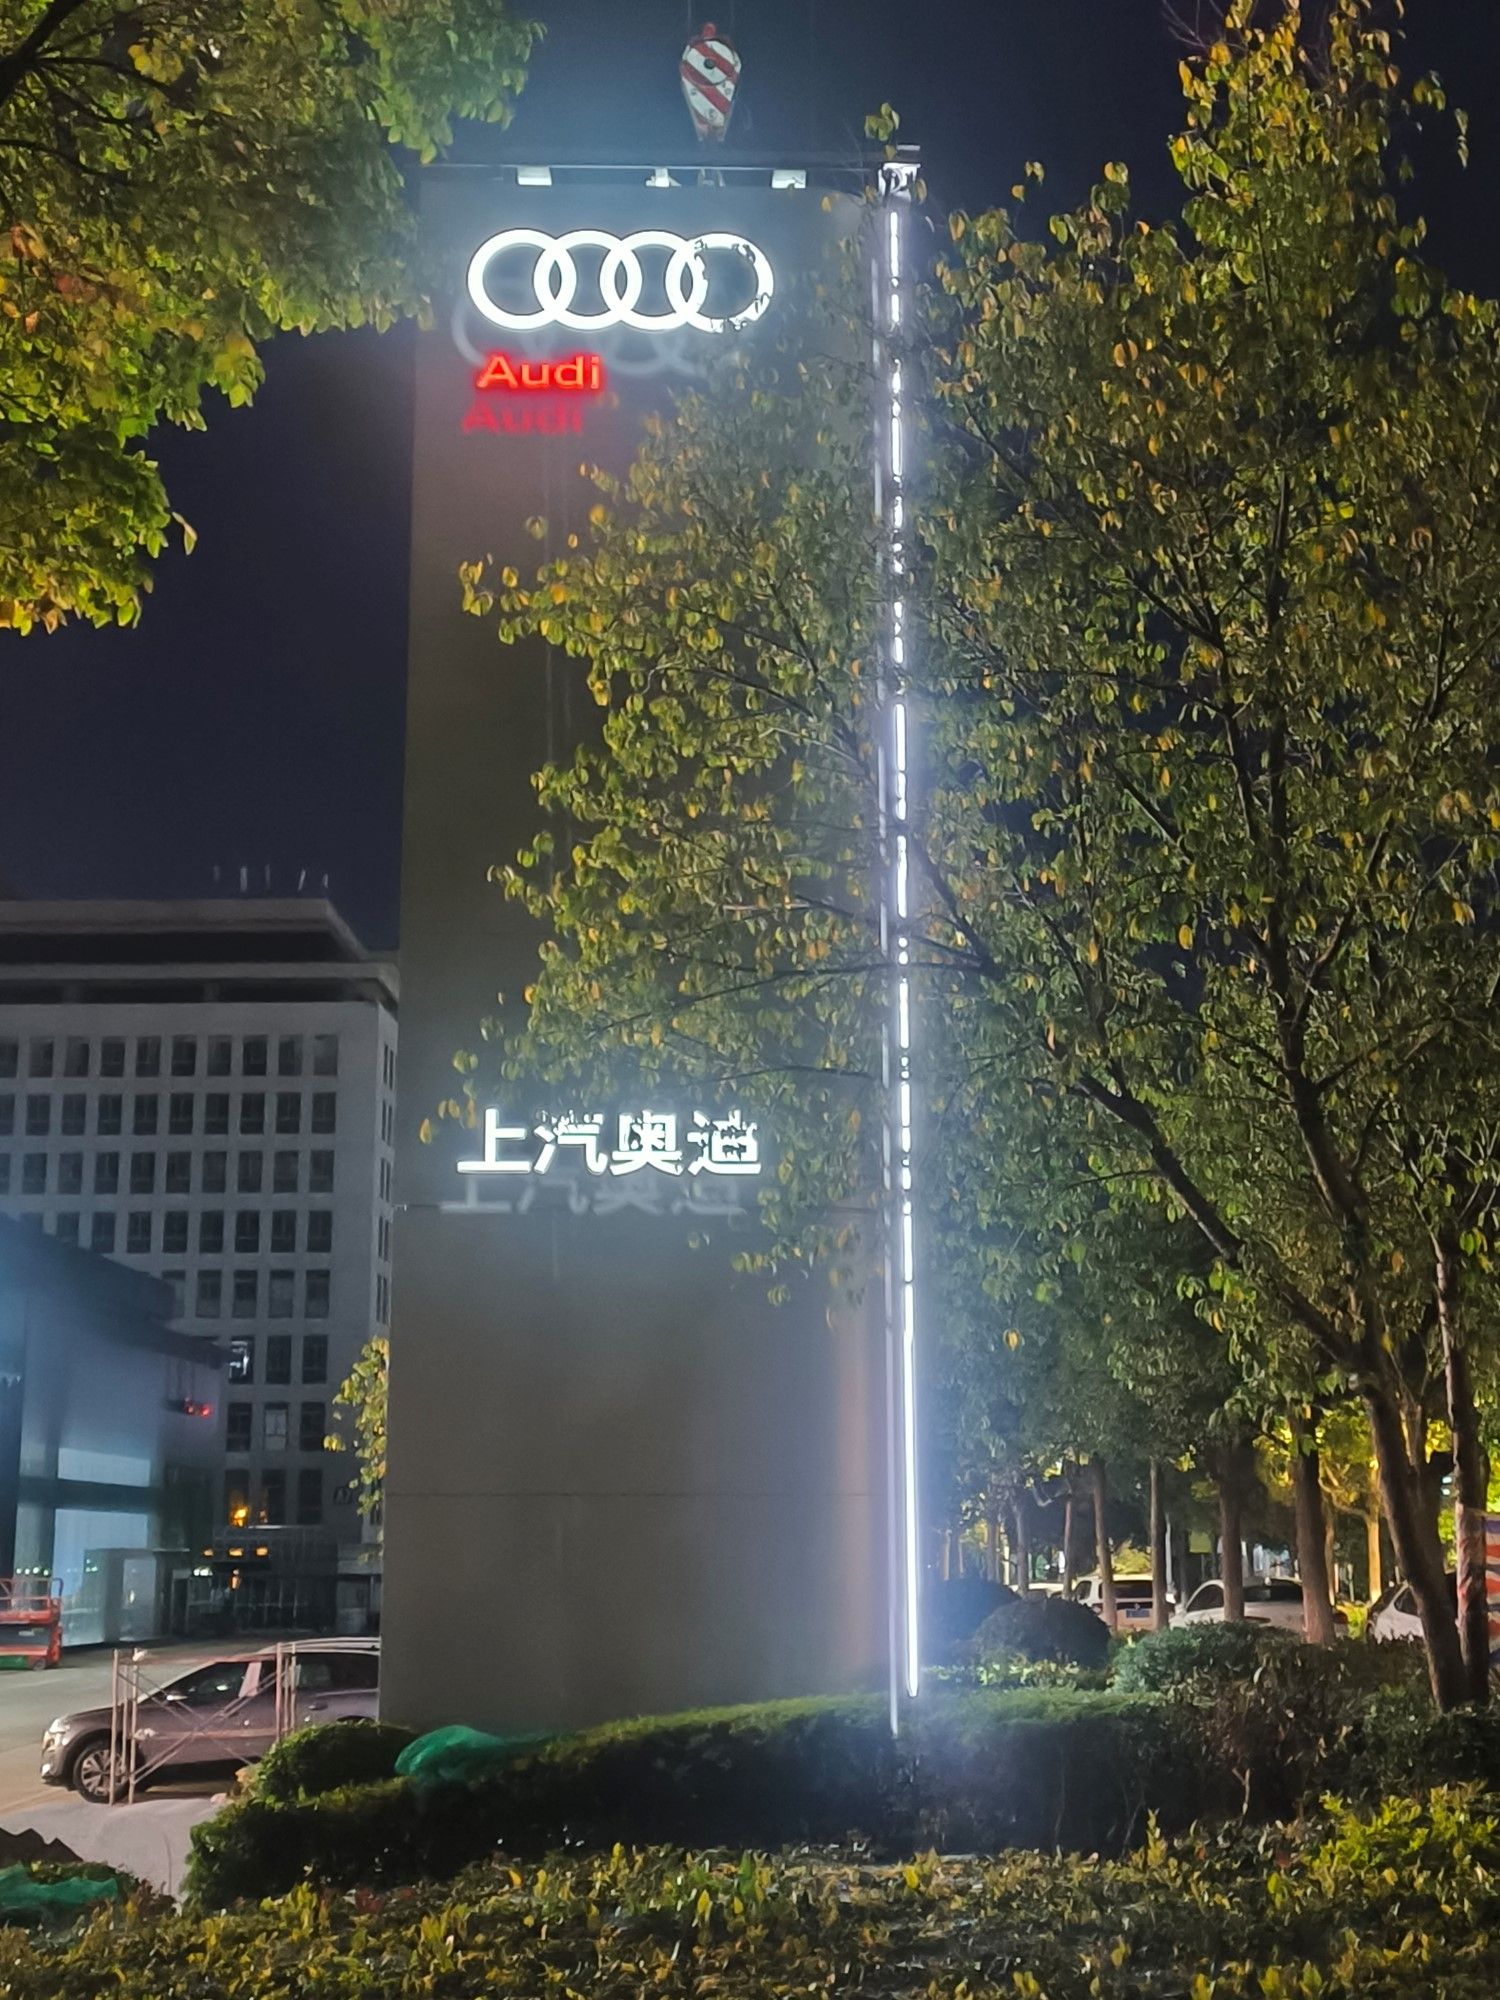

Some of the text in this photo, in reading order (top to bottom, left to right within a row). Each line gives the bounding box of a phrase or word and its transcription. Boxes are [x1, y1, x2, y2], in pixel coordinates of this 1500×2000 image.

[476, 355, 601, 389] Audi
[456, 1107, 762, 1175] 上汽奥迪
